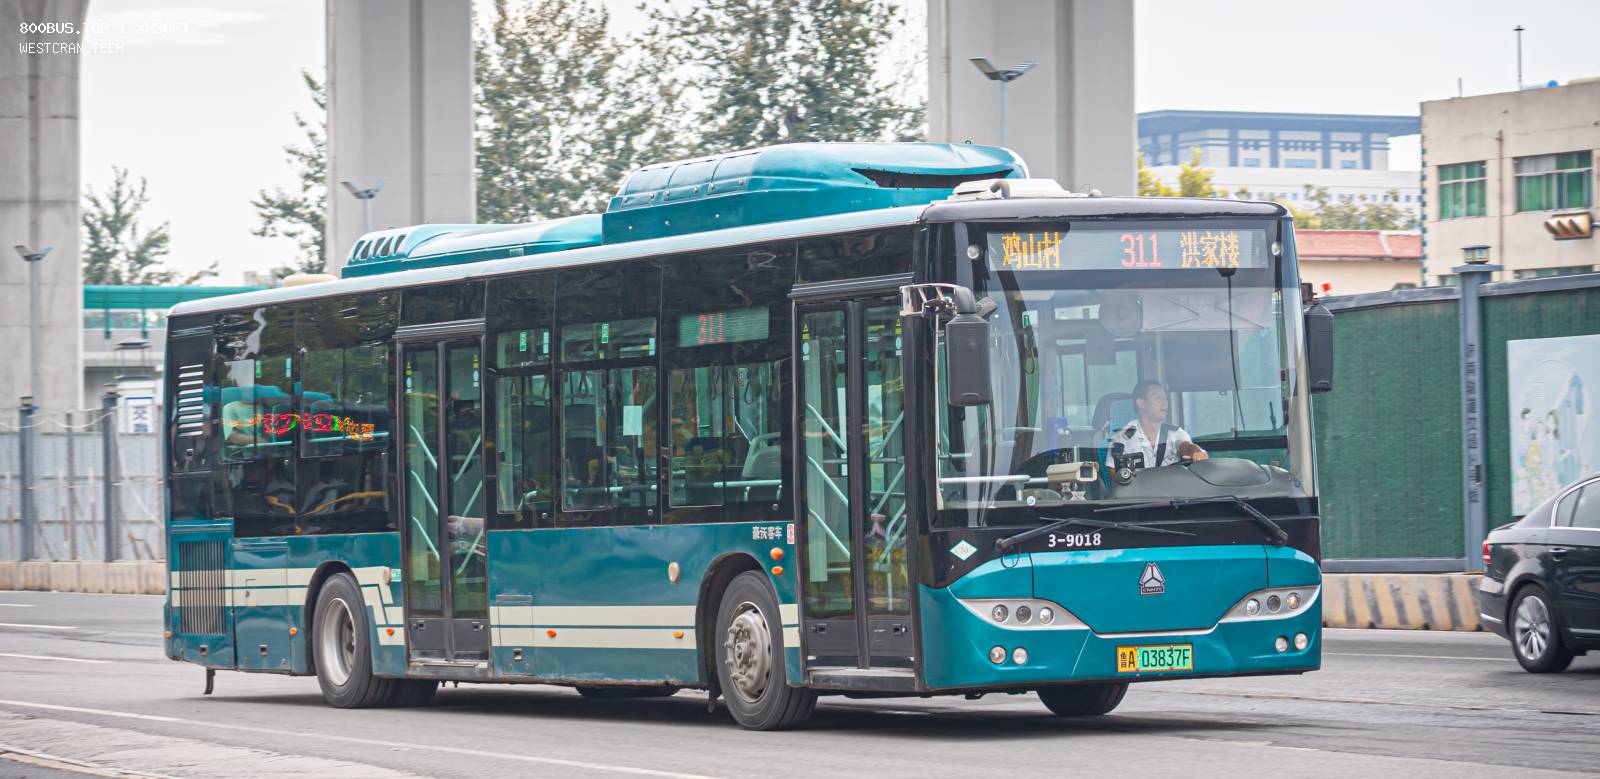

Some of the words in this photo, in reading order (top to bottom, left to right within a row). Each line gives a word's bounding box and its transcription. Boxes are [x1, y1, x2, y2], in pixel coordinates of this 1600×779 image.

[1001, 231, 1062, 269] 鸡山村
[1120, 233, 1162, 267] 311
[1179, 230, 1240, 268] 洪家楼
[698, 312, 724, 344] 311
[752, 526, 783, 540] 豪沃客车
[1048, 533, 1102, 547] 3-9018
[1142, 649, 1190, 668] 03837F
